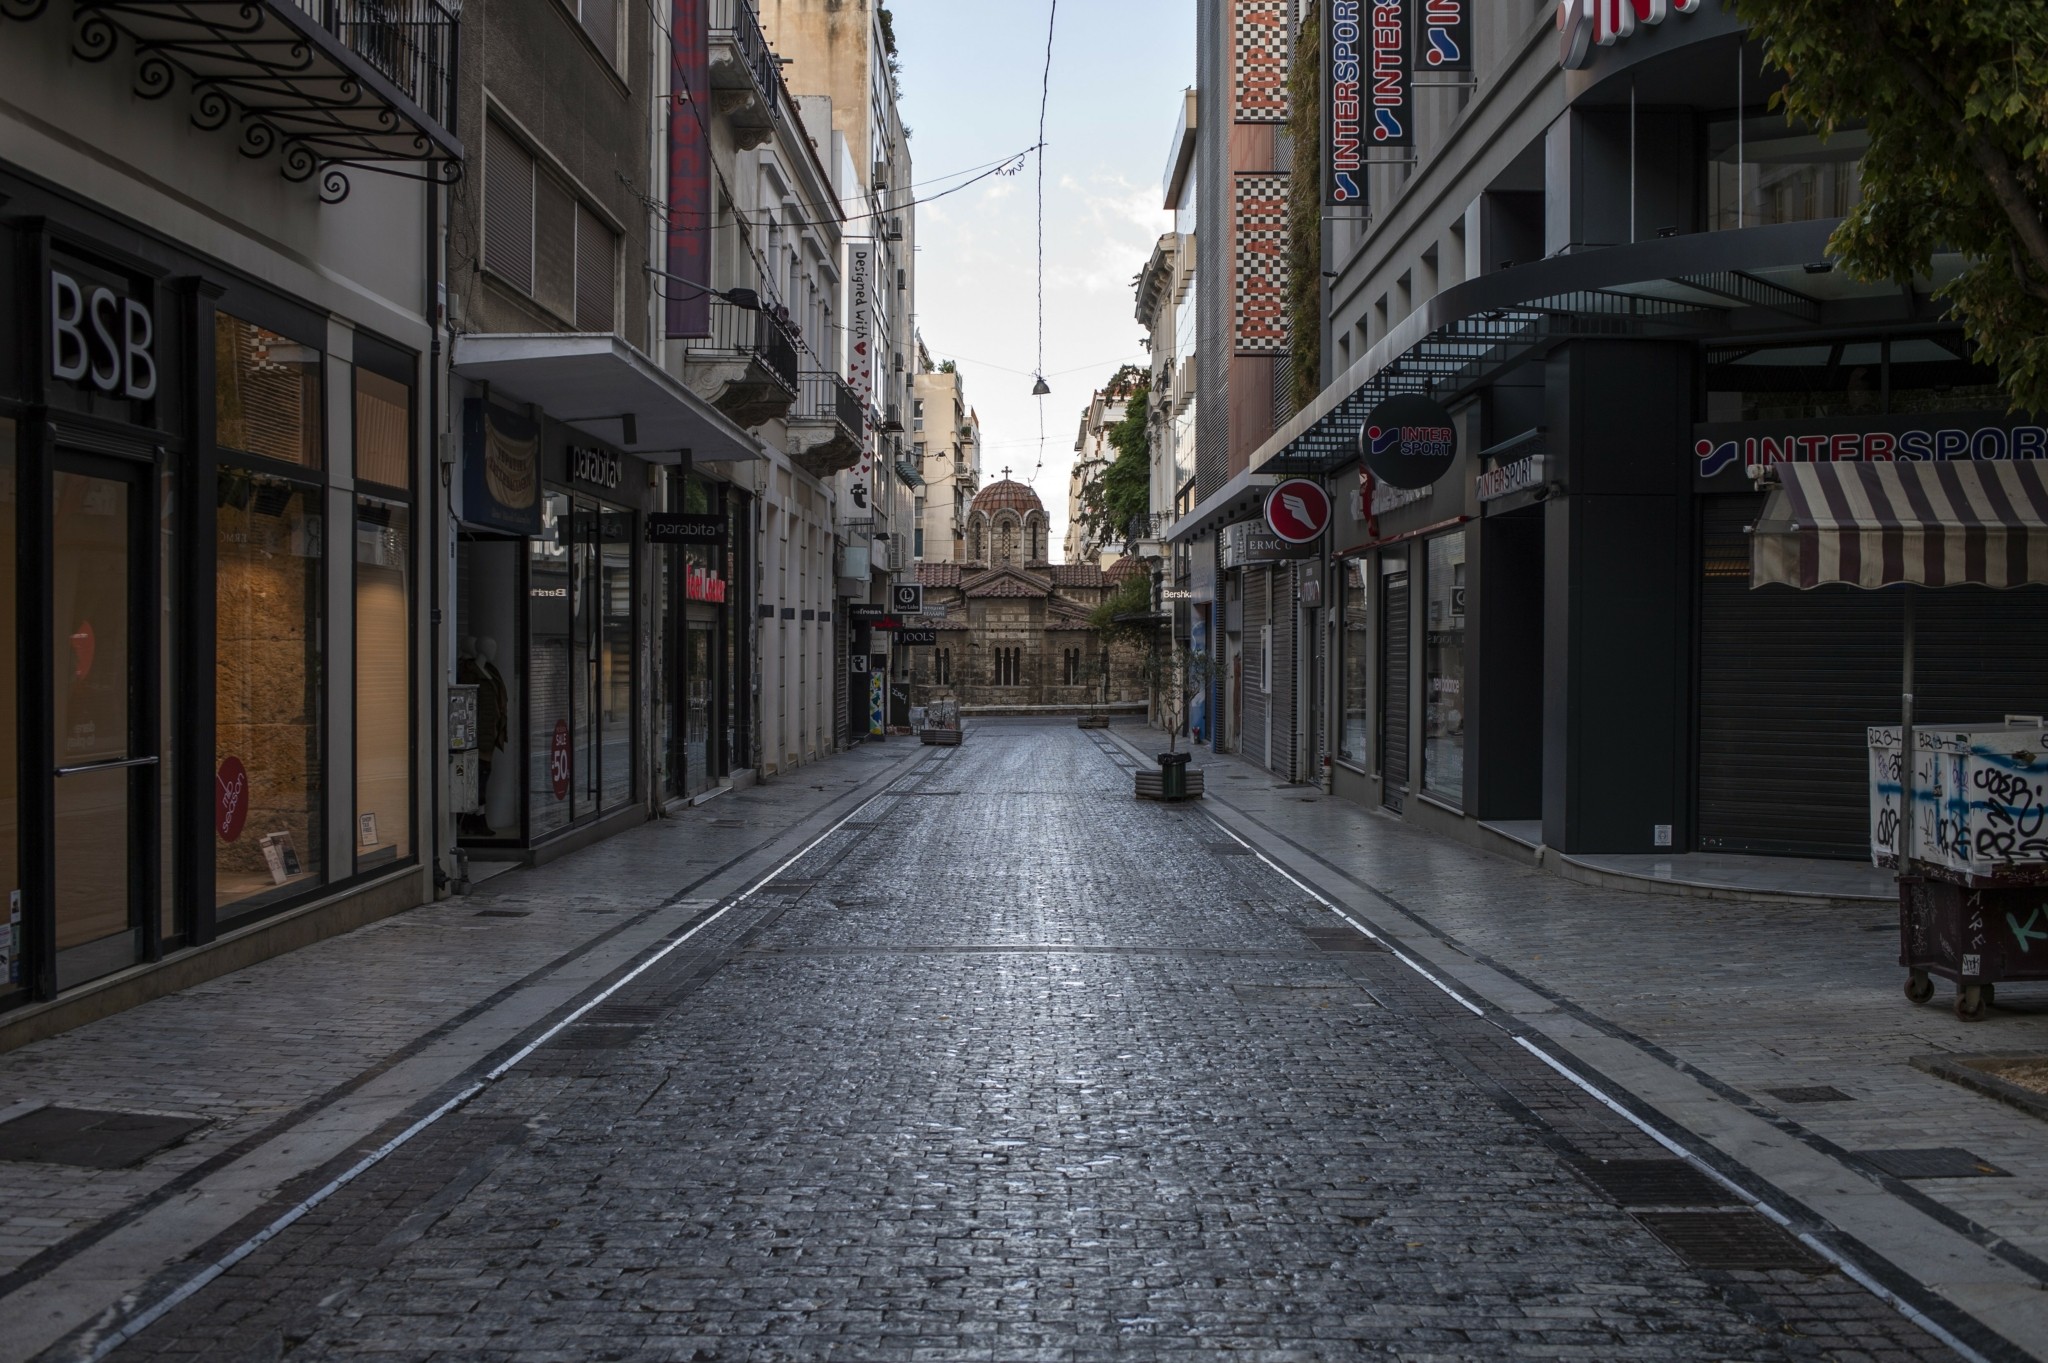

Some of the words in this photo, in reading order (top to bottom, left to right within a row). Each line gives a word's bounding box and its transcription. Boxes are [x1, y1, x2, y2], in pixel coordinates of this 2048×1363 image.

[1241, 0, 1285, 112] POP-A
[1373, 0, 1403, 107] INTER
[1333, 0, 1361, 170] INTERSPOR
[851, 251, 868, 307] Designed
[50, 270, 157, 401] BSB
[855, 310, 867, 339] with
[1400, 441, 1451, 456] SPORT
[1401, 426, 1452, 441] INTER
[1744, 426, 2048, 465] INTERSPOR
[573, 446, 617, 489] parabita
[1482, 456, 1533, 497] INTERSPORT
[656, 523, 716, 536] parabita
[903, 632, 935, 643] JOOLS
[222, 772, 245, 834] season
